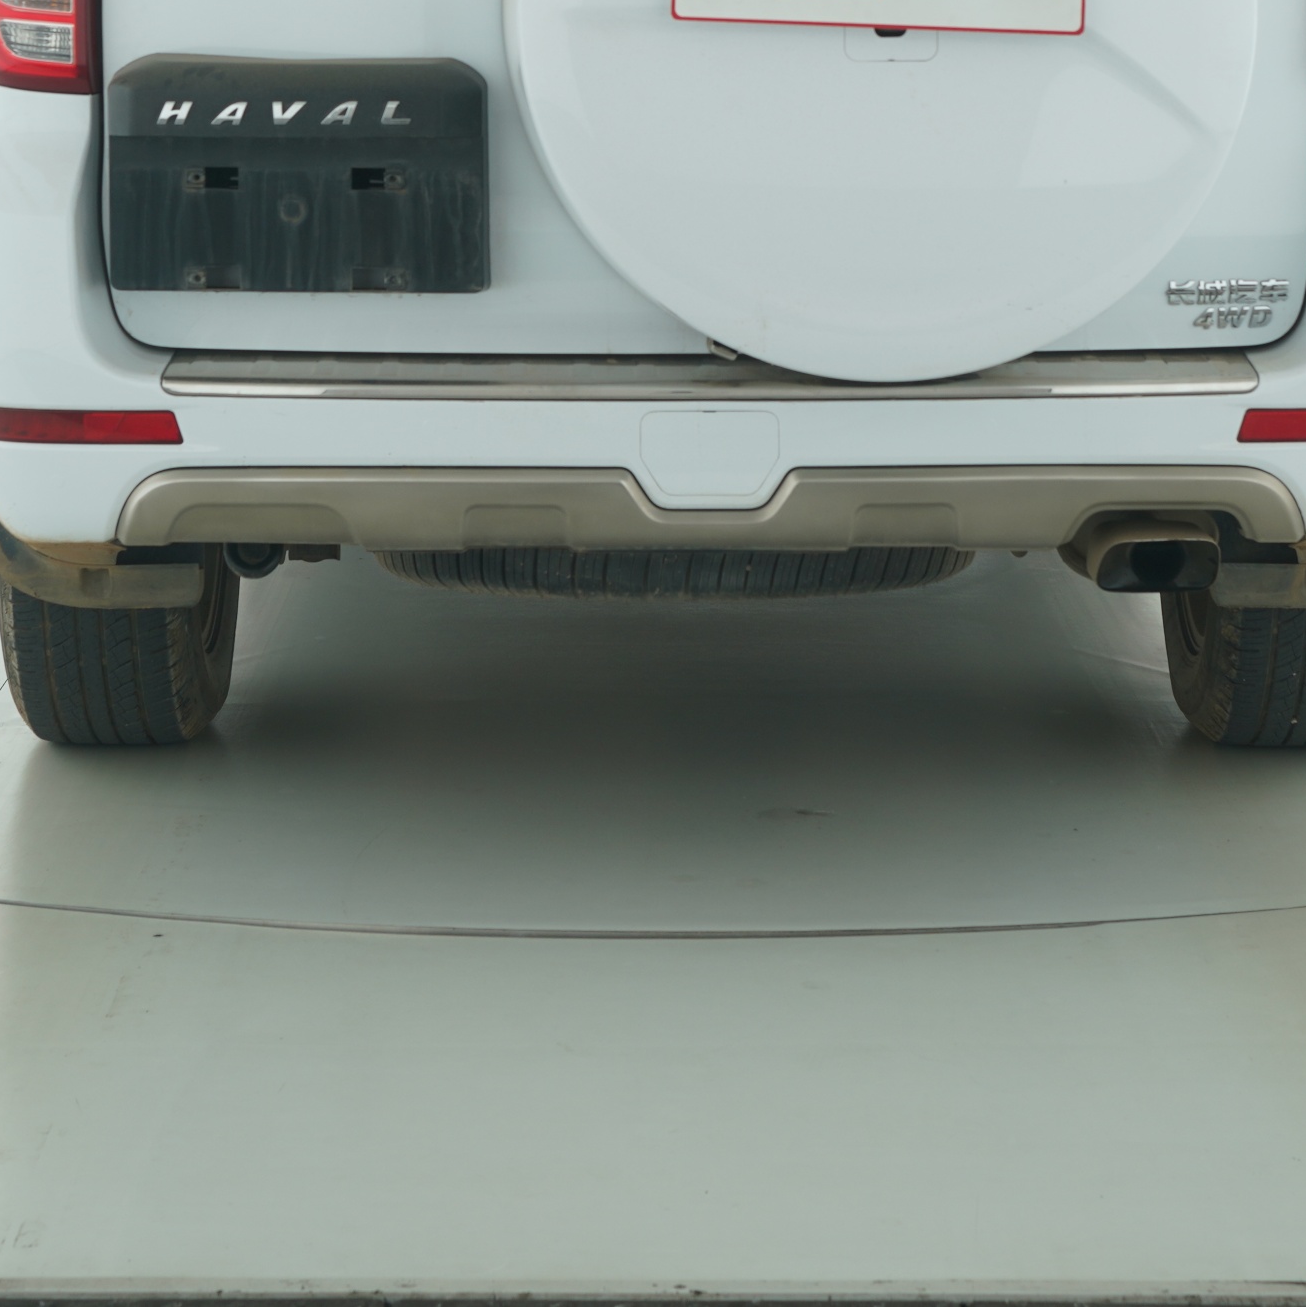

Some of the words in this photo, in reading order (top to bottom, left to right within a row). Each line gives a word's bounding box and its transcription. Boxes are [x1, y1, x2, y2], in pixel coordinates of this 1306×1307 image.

[156, 100, 411, 125] HAVAL
[1166, 279, 1290, 305] 长城汽车
[1193, 305, 1272, 329] 4WD
